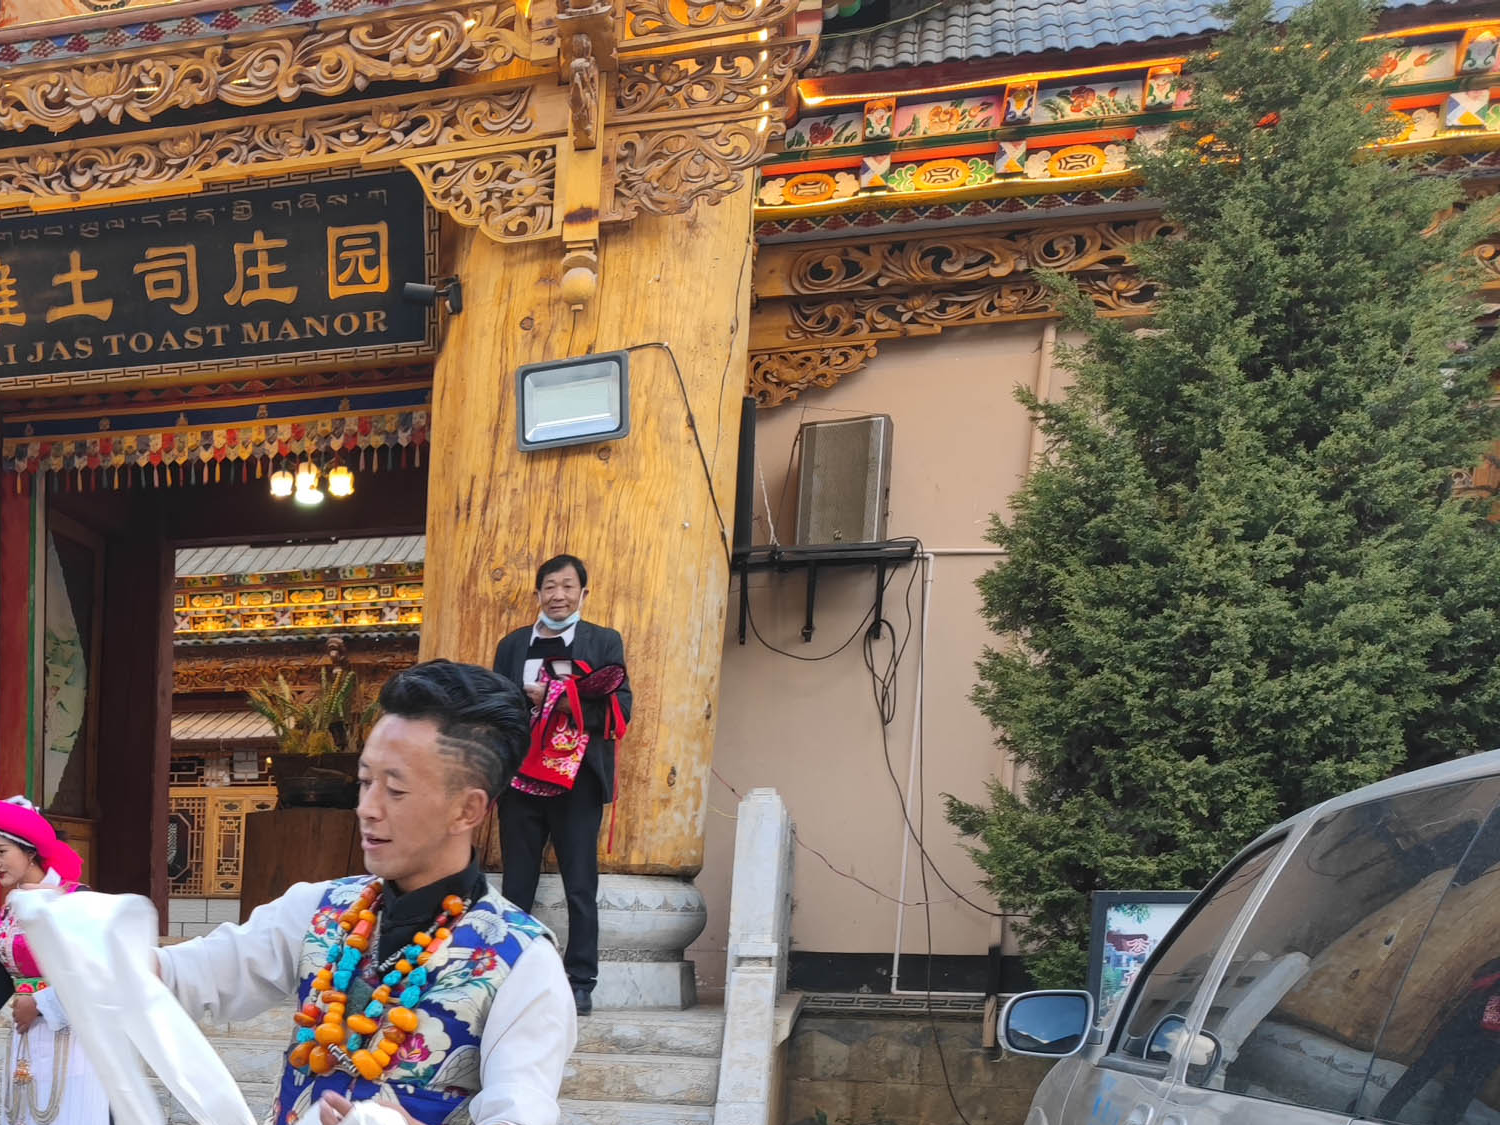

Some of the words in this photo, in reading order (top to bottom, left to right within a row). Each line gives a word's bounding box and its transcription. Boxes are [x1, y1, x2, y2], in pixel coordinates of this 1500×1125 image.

[27, 336, 93, 364] JAS
[103, 324, 230, 356] TOAST
[242, 309, 389, 346] MANOR
